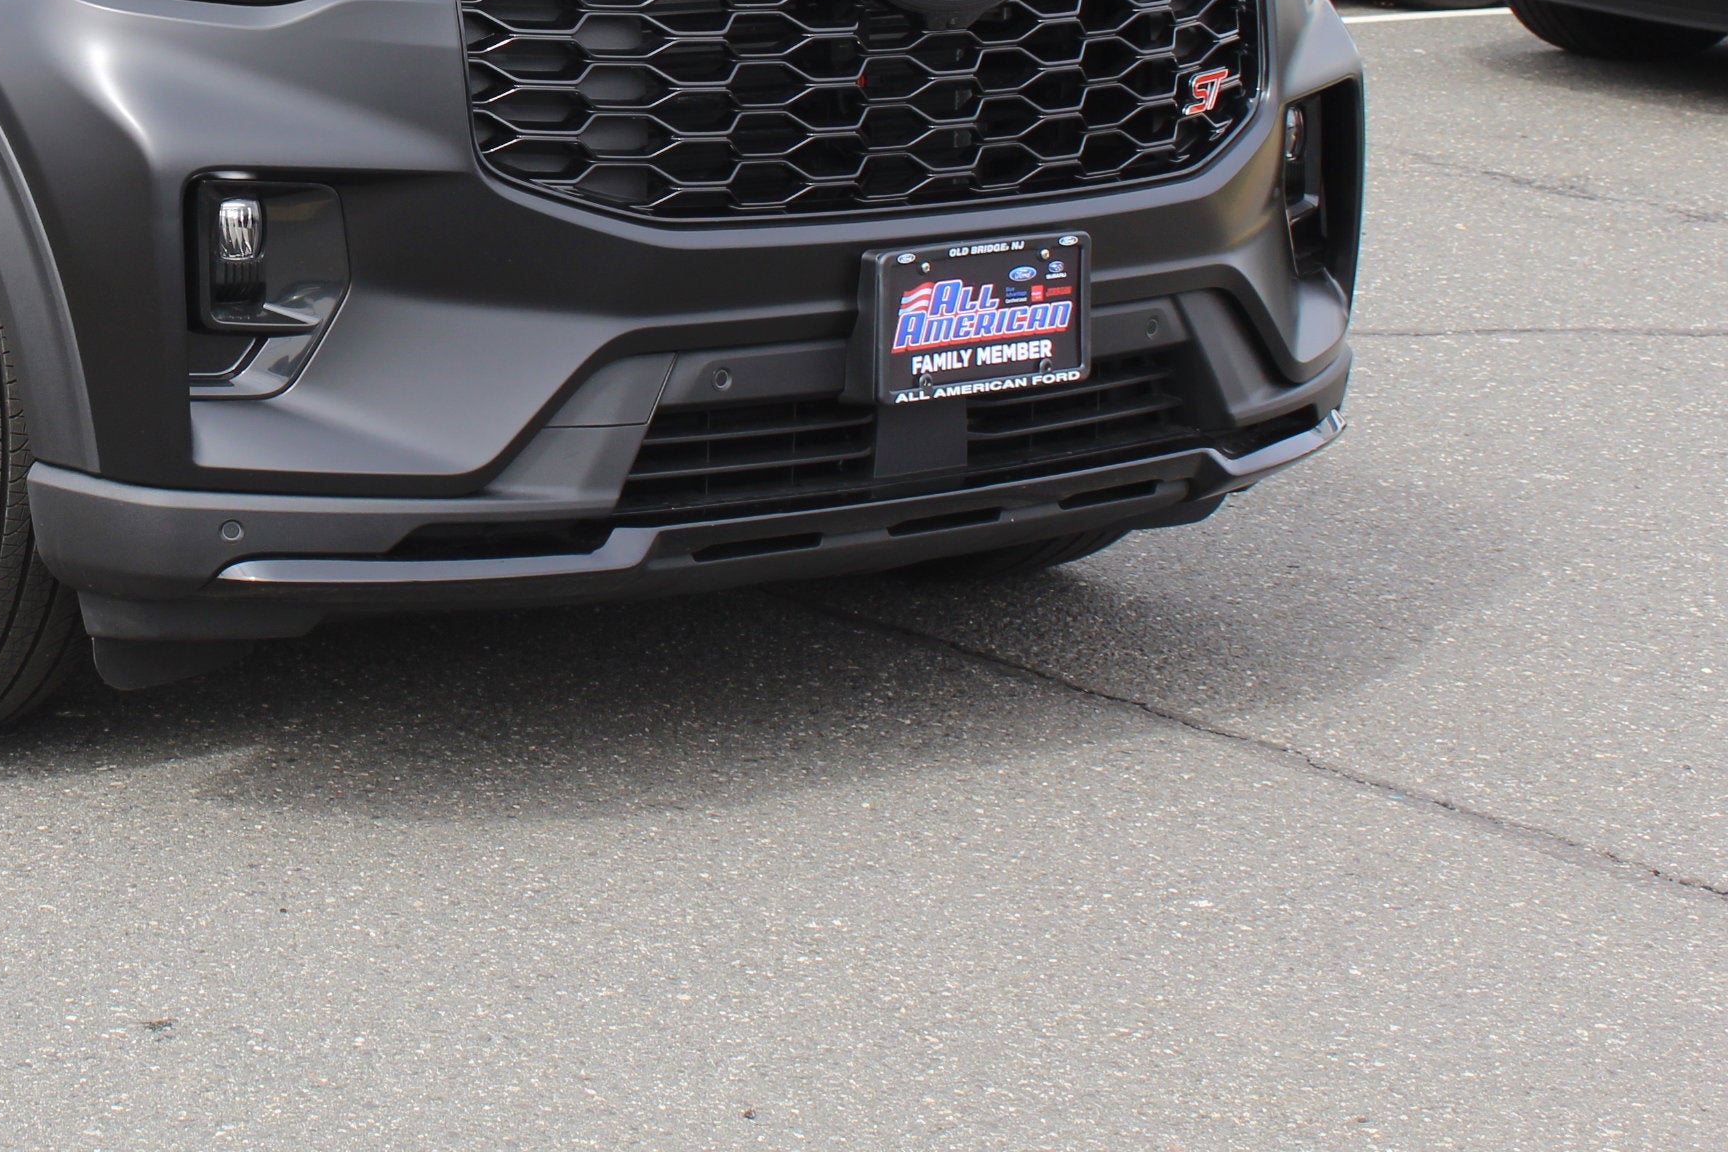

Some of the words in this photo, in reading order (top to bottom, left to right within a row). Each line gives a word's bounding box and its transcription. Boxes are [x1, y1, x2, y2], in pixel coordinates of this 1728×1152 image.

[1185, 67, 1229, 116] ST
[949, 247, 969, 257] OLD
[1011, 241, 1024, 250] NJ
[892, 301, 1072, 350] AMERICAN
[911, 348, 972, 375] FAMILY
[976, 339, 1052, 366] MEMBER
[895, 392, 929, 404] ALL
[933, 375, 1029, 398] AMERICAN
[1032, 371, 1081, 386] FORD
